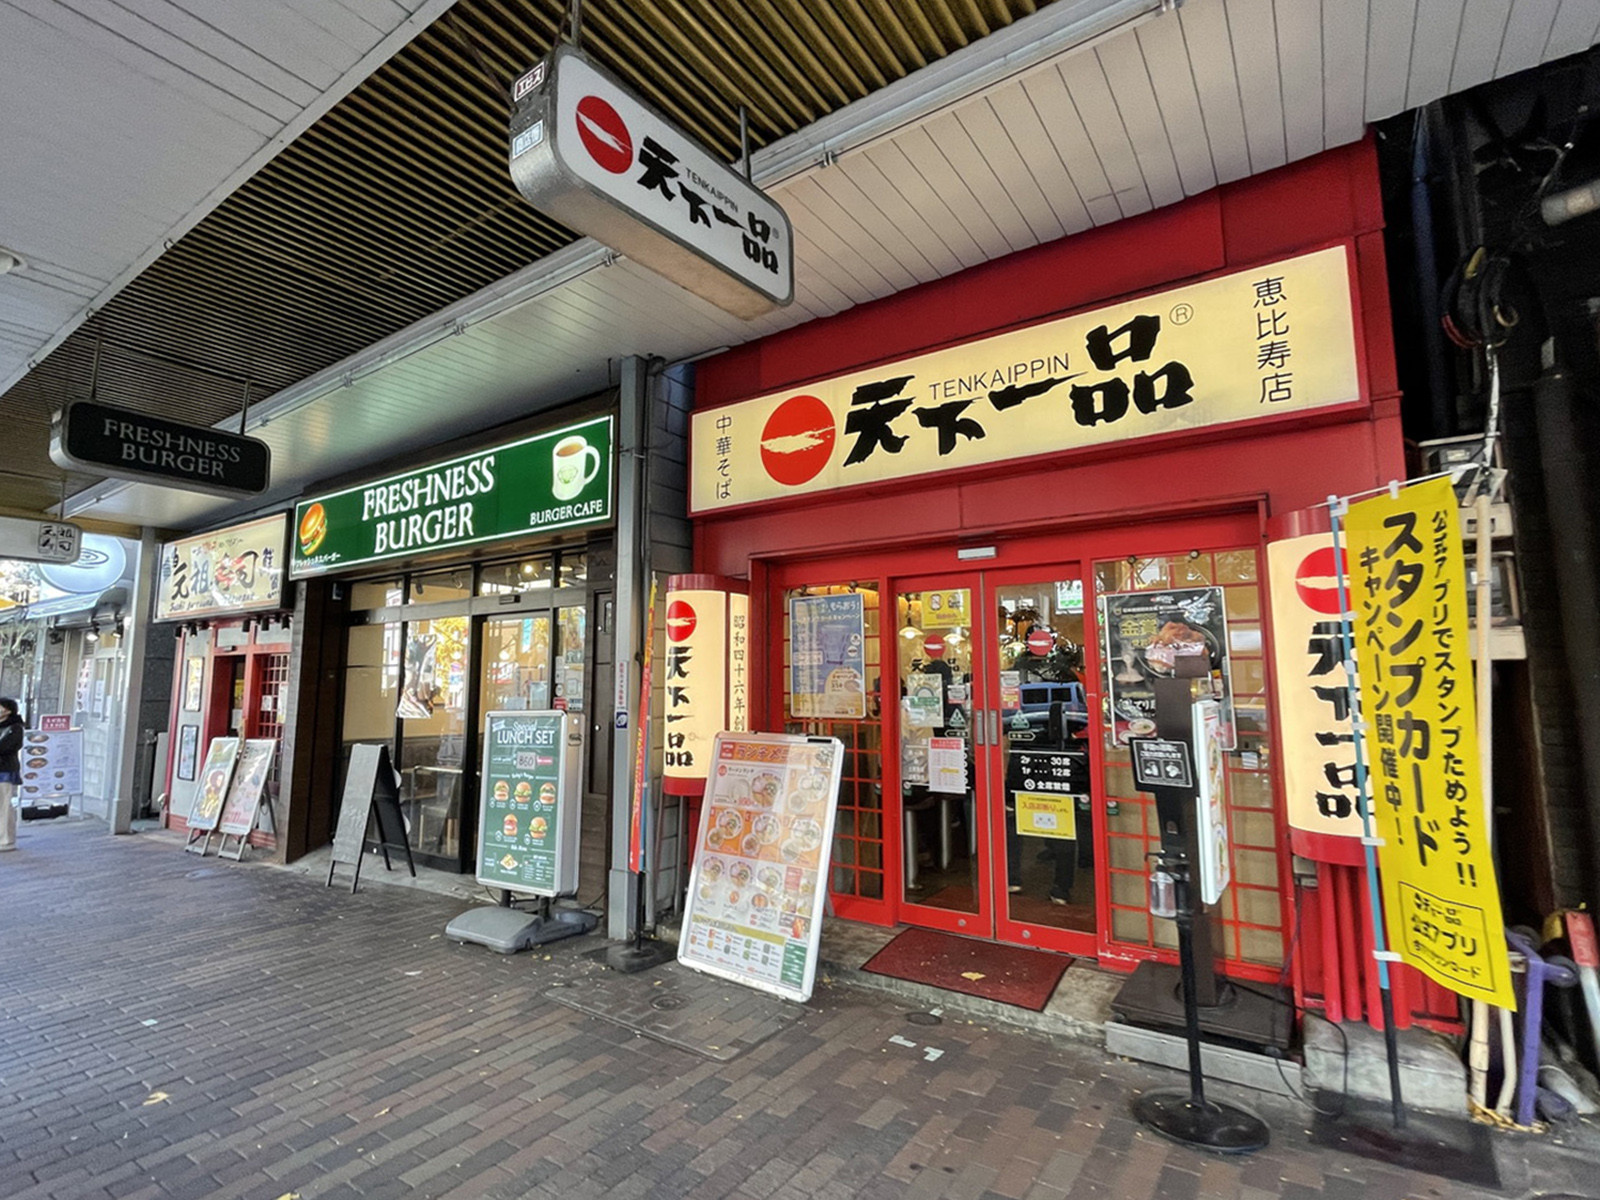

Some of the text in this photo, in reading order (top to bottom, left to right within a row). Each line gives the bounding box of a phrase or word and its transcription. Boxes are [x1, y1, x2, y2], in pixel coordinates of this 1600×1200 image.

[637, 135, 778, 275] 天下一品
[684, 167, 739, 213] TENKAIPPIN
[1252, 276, 1293, 404] 恵比寿店
[843, 314, 1194, 467] 天下一品
[929, 352, 1069, 400] TENKAIPPIN
[103, 418, 241, 464] FRESHNESS
[121, 442, 225, 479] BURGER
[716, 414, 732, 500] 中華そば
[361, 454, 496, 522] FRESHNESS
[374, 501, 475, 554] BURGER
[665, 645, 694, 767] 天下一品
[1384, 511, 1441, 867] スタンプカード
[497, 730, 555, 745] LUNCH SET
